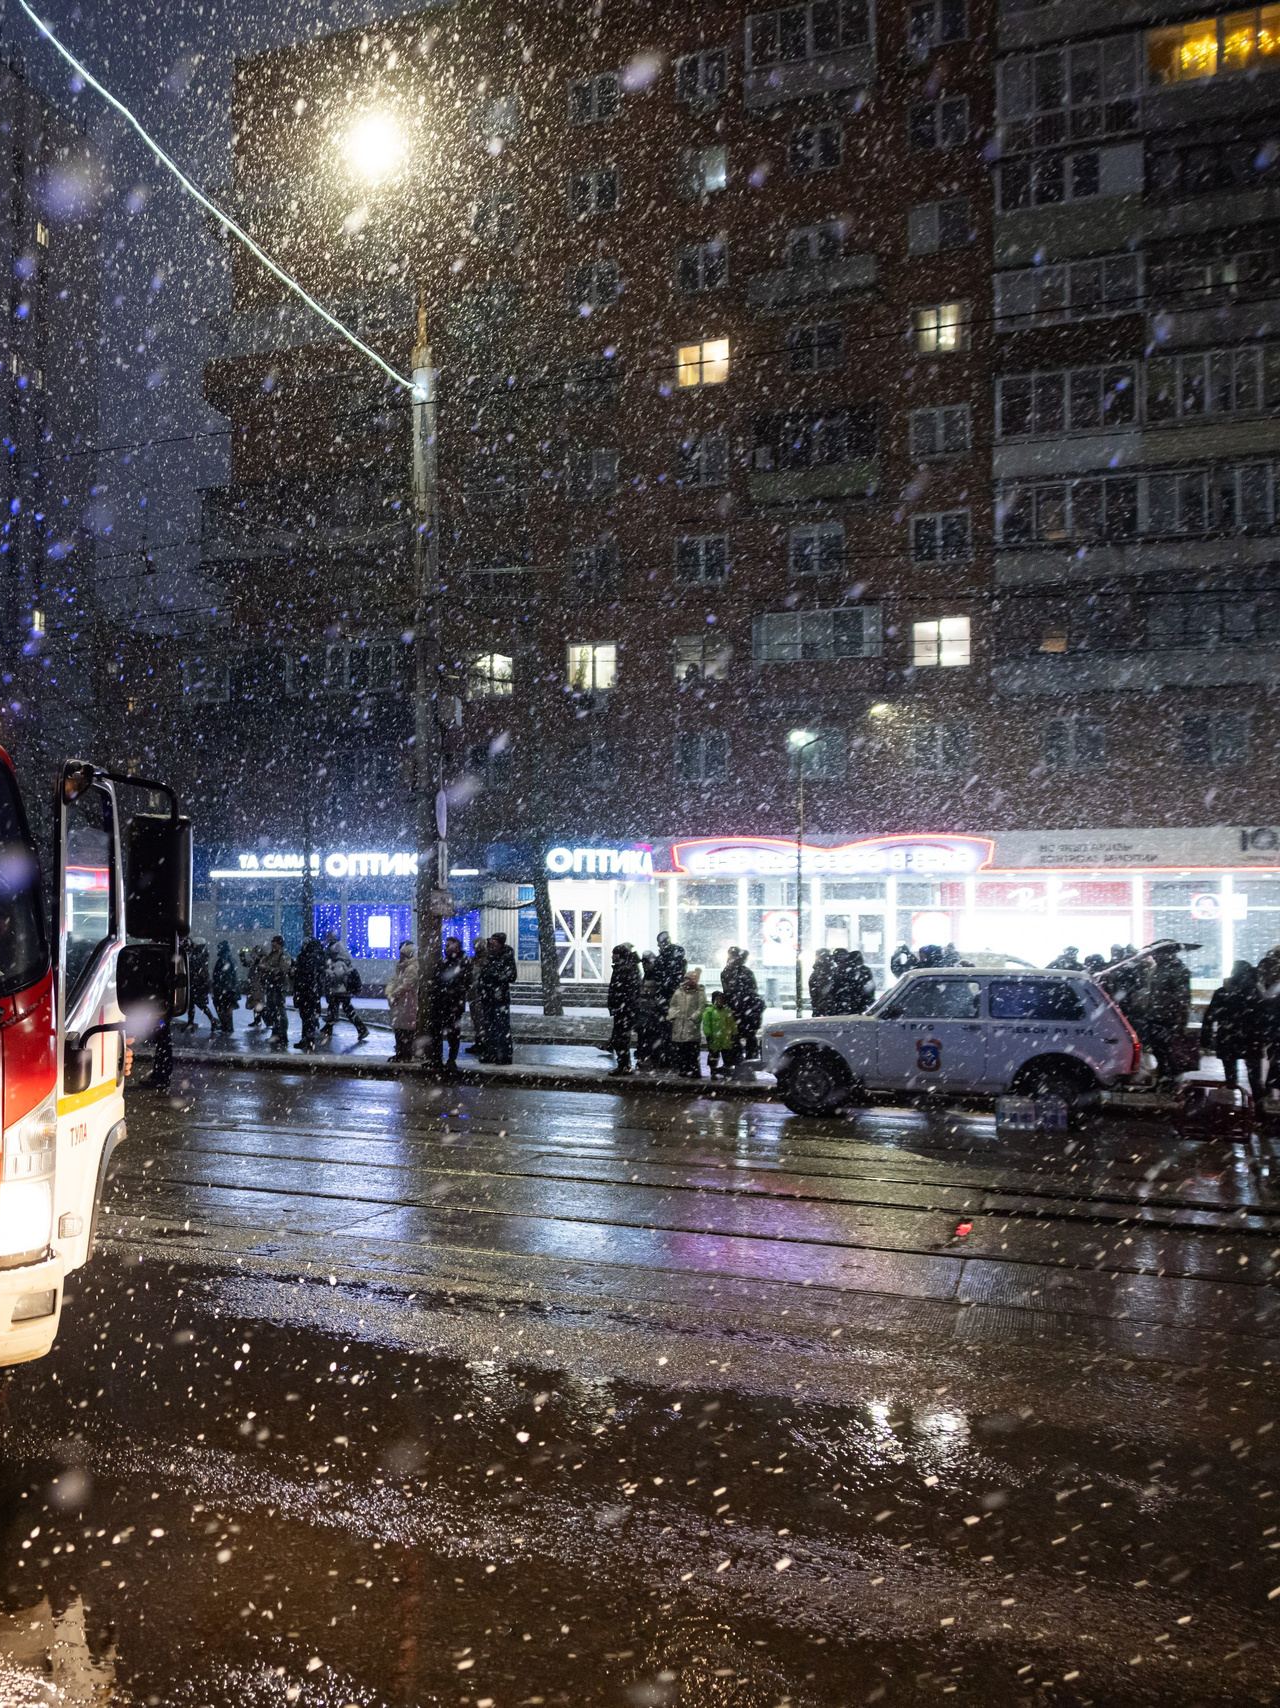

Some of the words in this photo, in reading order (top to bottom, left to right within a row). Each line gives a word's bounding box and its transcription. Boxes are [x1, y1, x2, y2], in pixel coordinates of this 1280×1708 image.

[238, 854, 259, 869] ТА
[325, 853, 419, 876] ОПТИК
[546, 847, 654, 874] ОПТИКА
[70, 1122, 88, 1147] ТУЛА
